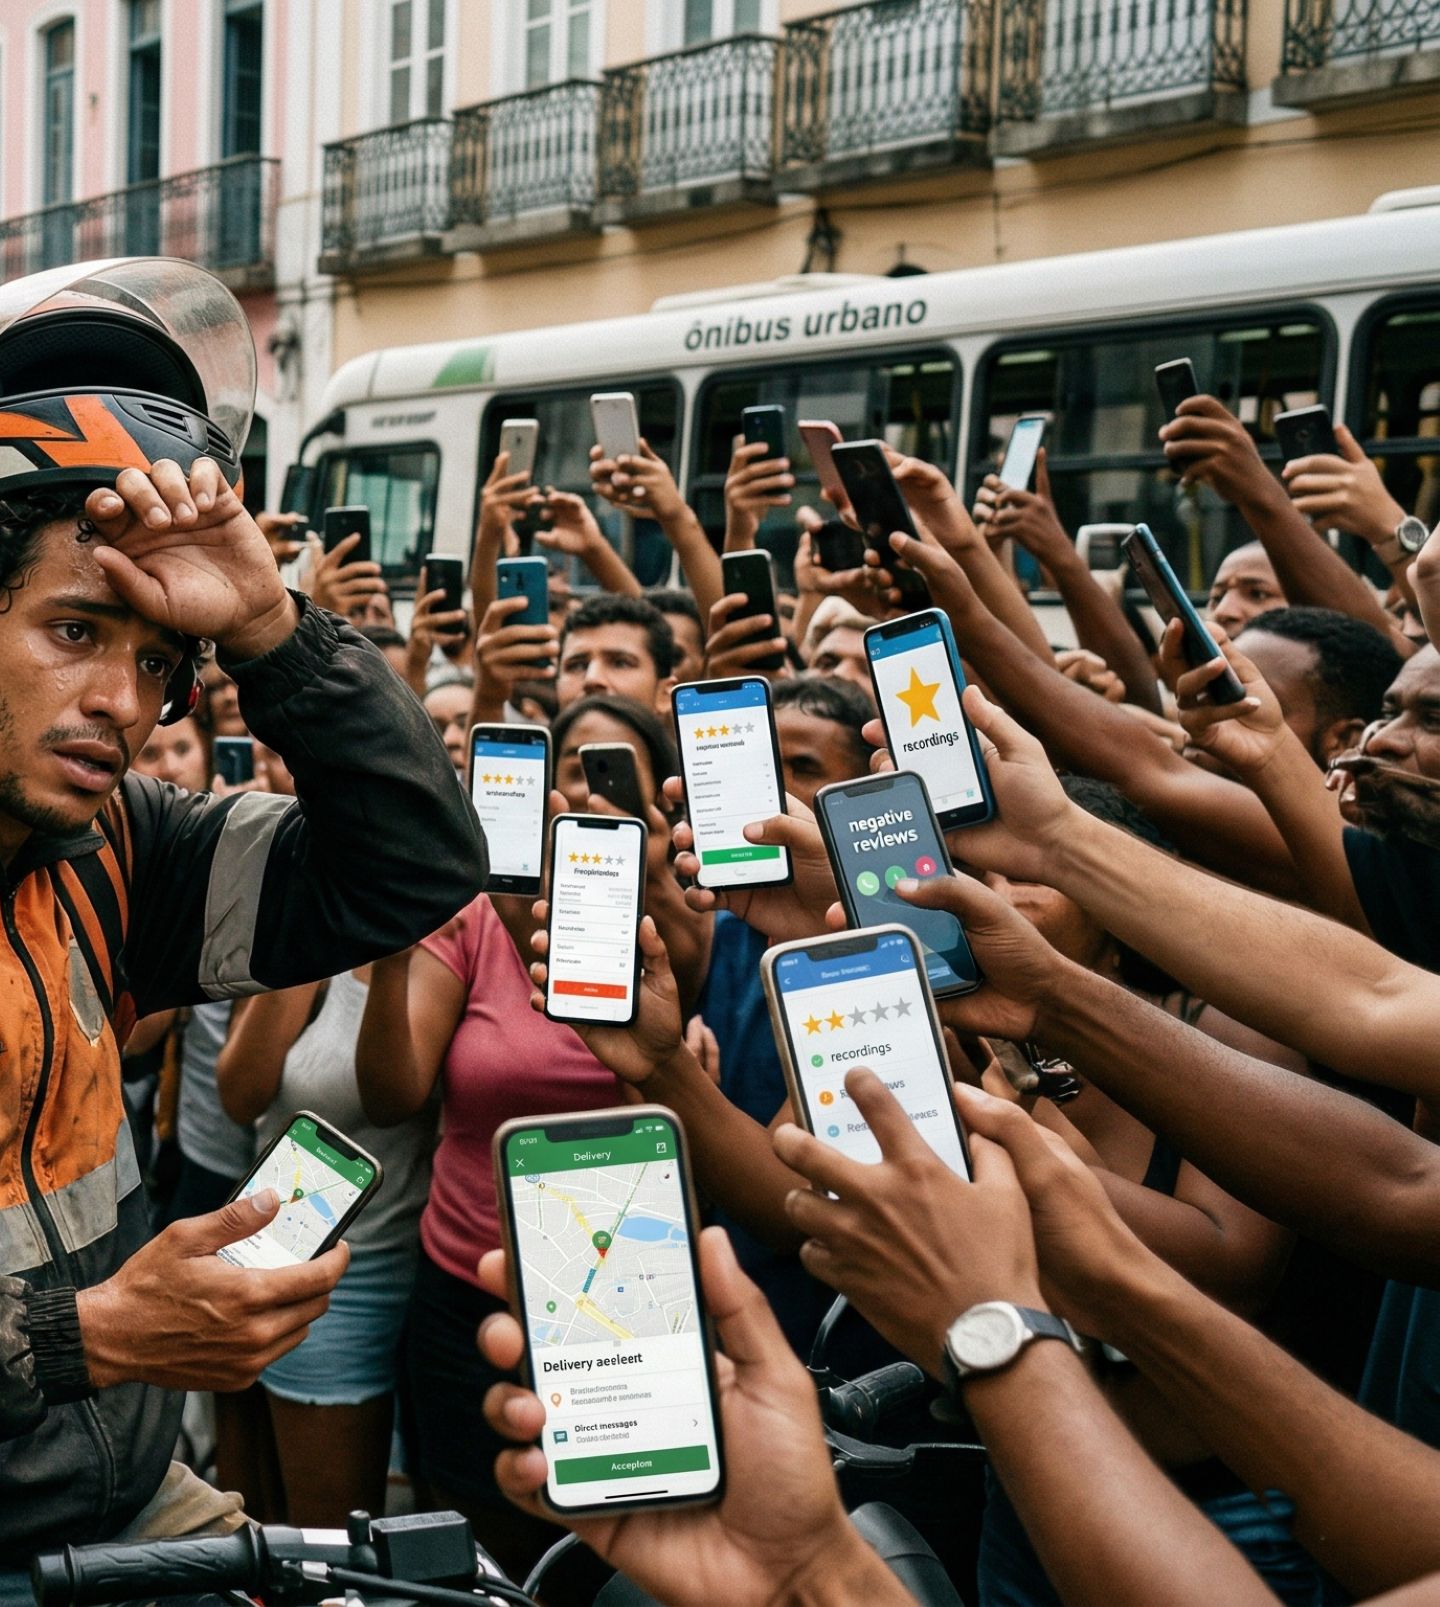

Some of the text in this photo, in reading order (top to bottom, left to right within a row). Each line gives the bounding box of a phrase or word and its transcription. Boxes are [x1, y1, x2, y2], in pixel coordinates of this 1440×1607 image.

[684, 299, 927, 351] ônibus urbano
[848, 808, 913, 833] negative
[830, 1042, 892, 1063] recordings
[573, 1151, 611, 1162] Delivery
[543, 1358, 593, 1373] Delivery
